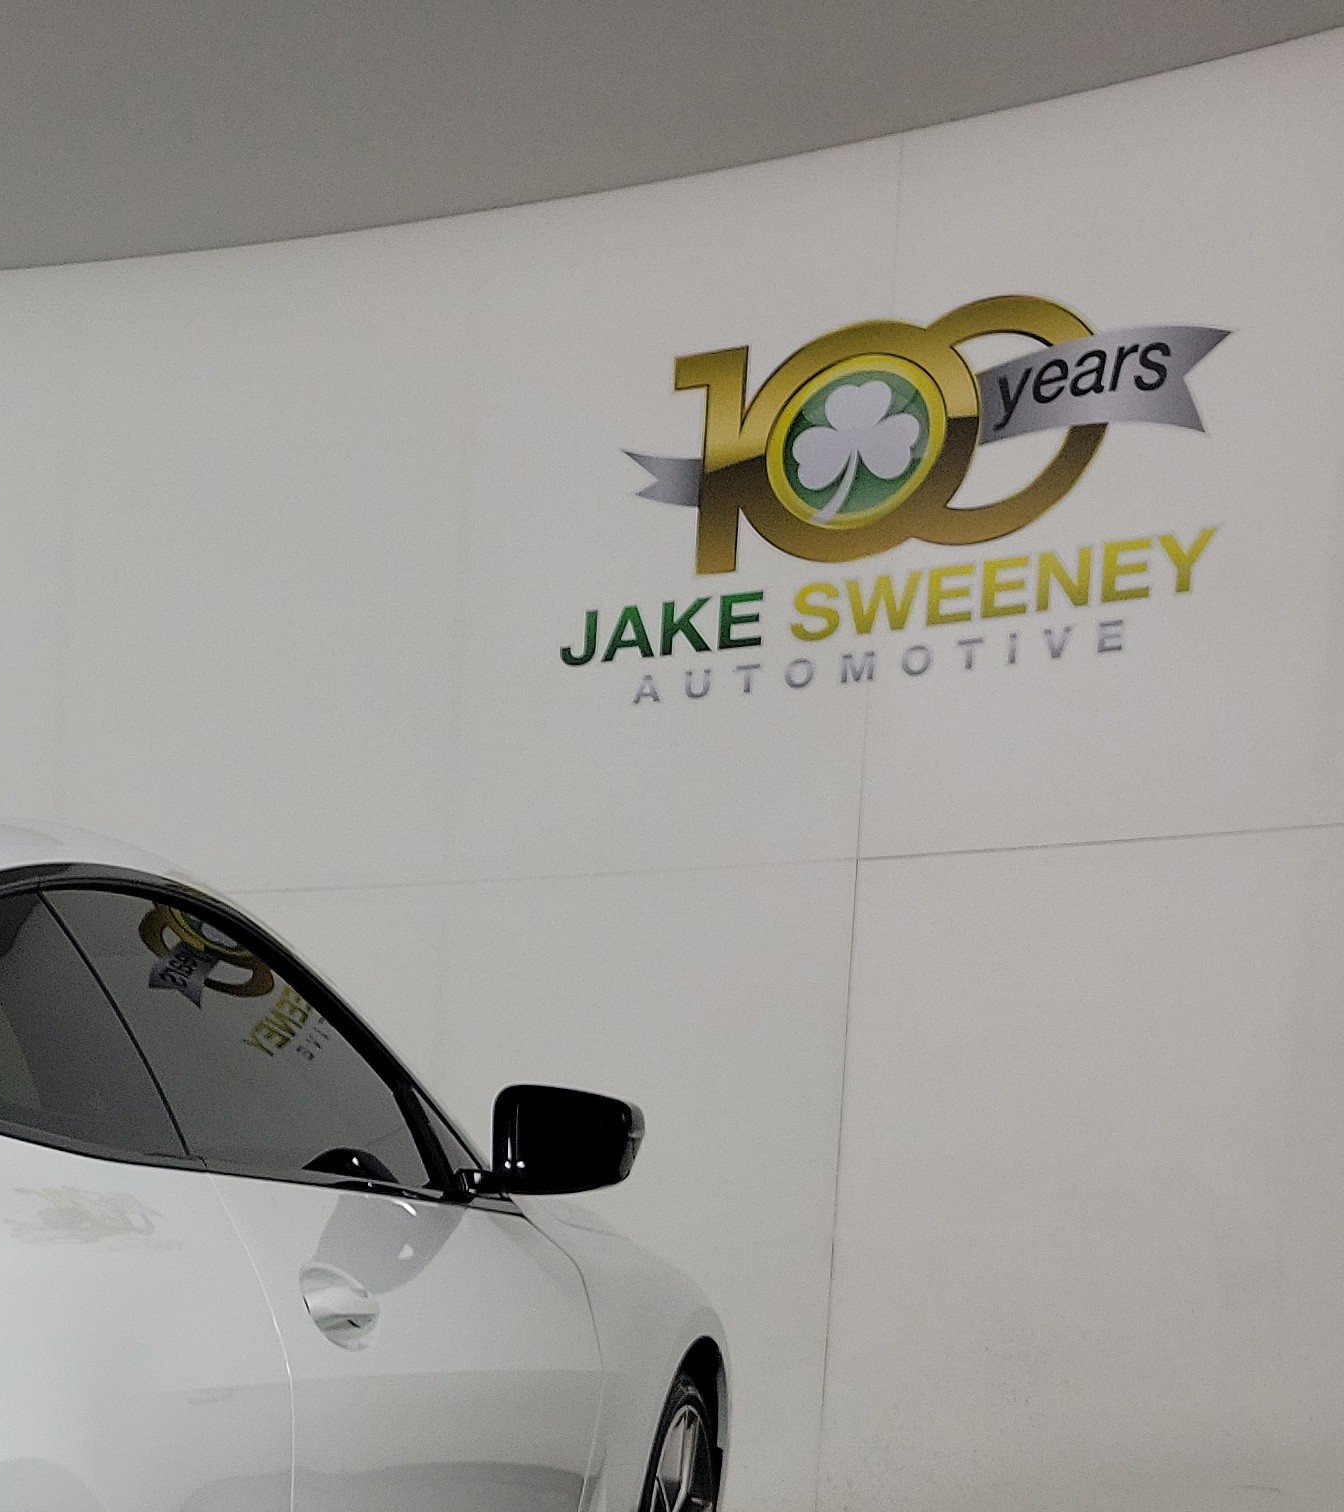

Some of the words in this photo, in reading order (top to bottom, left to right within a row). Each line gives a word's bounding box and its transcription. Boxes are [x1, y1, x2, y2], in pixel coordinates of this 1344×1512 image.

[673, 294, 1108, 576] 100
[992, 339, 1171, 430] years
[560, 590, 765, 667] JAKE
[789, 528, 1217, 643] SWEENEY
[632, 620, 1127, 705] AUTOMOTIVE
